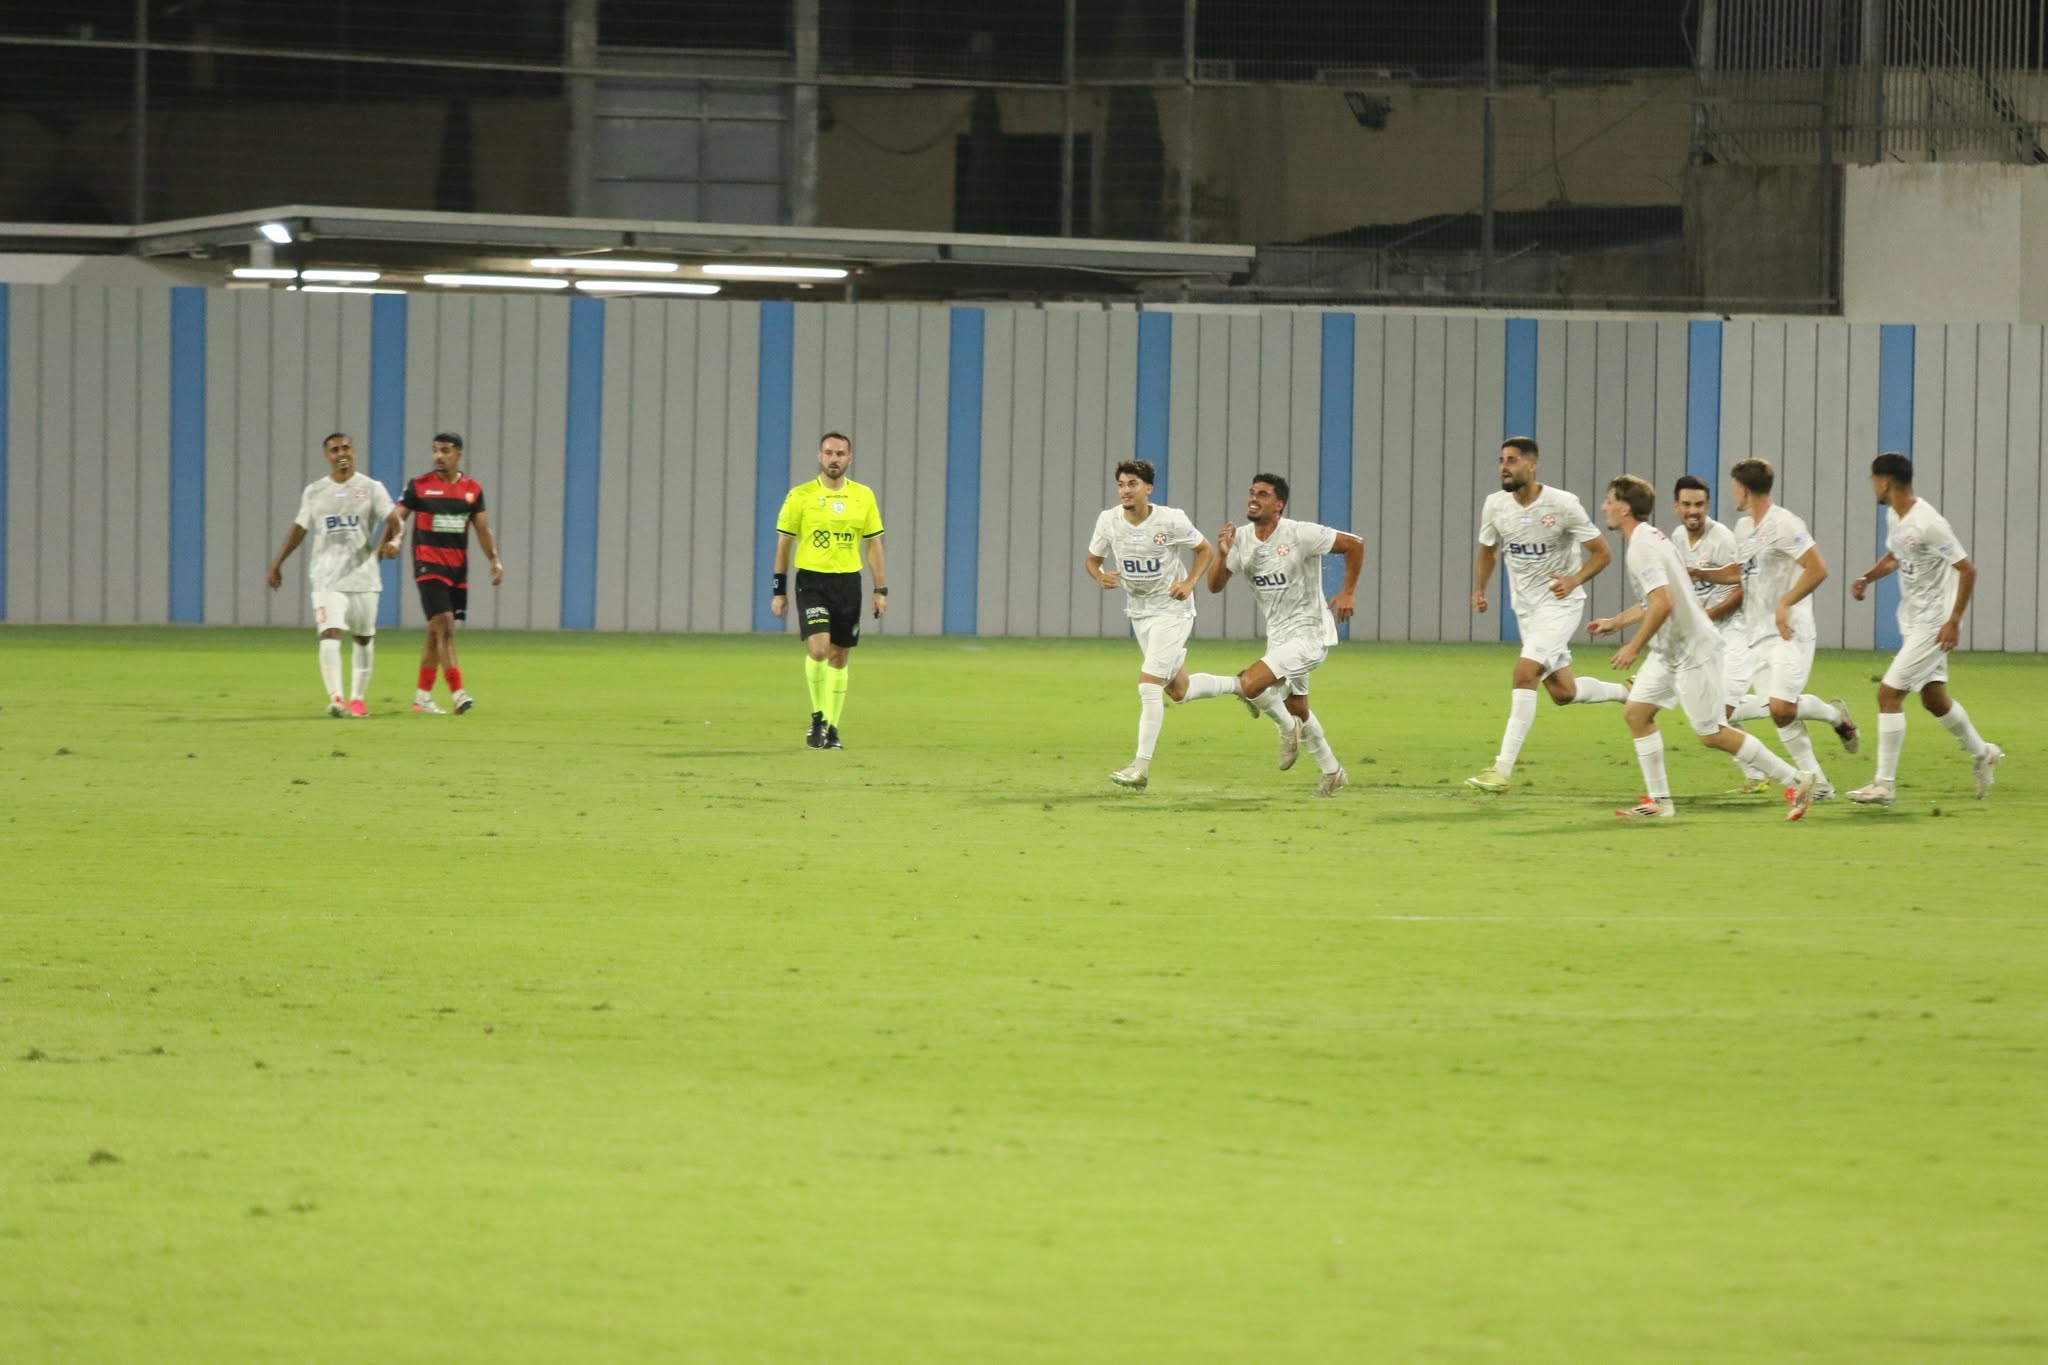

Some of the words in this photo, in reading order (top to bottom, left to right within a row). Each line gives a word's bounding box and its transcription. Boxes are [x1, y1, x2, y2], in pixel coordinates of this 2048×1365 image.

[326, 515, 359, 529] BLU
[1510, 543, 1546, 555] BLU
[1123, 559, 1161, 573] BLU
[1253, 573, 1286, 587] BLU
